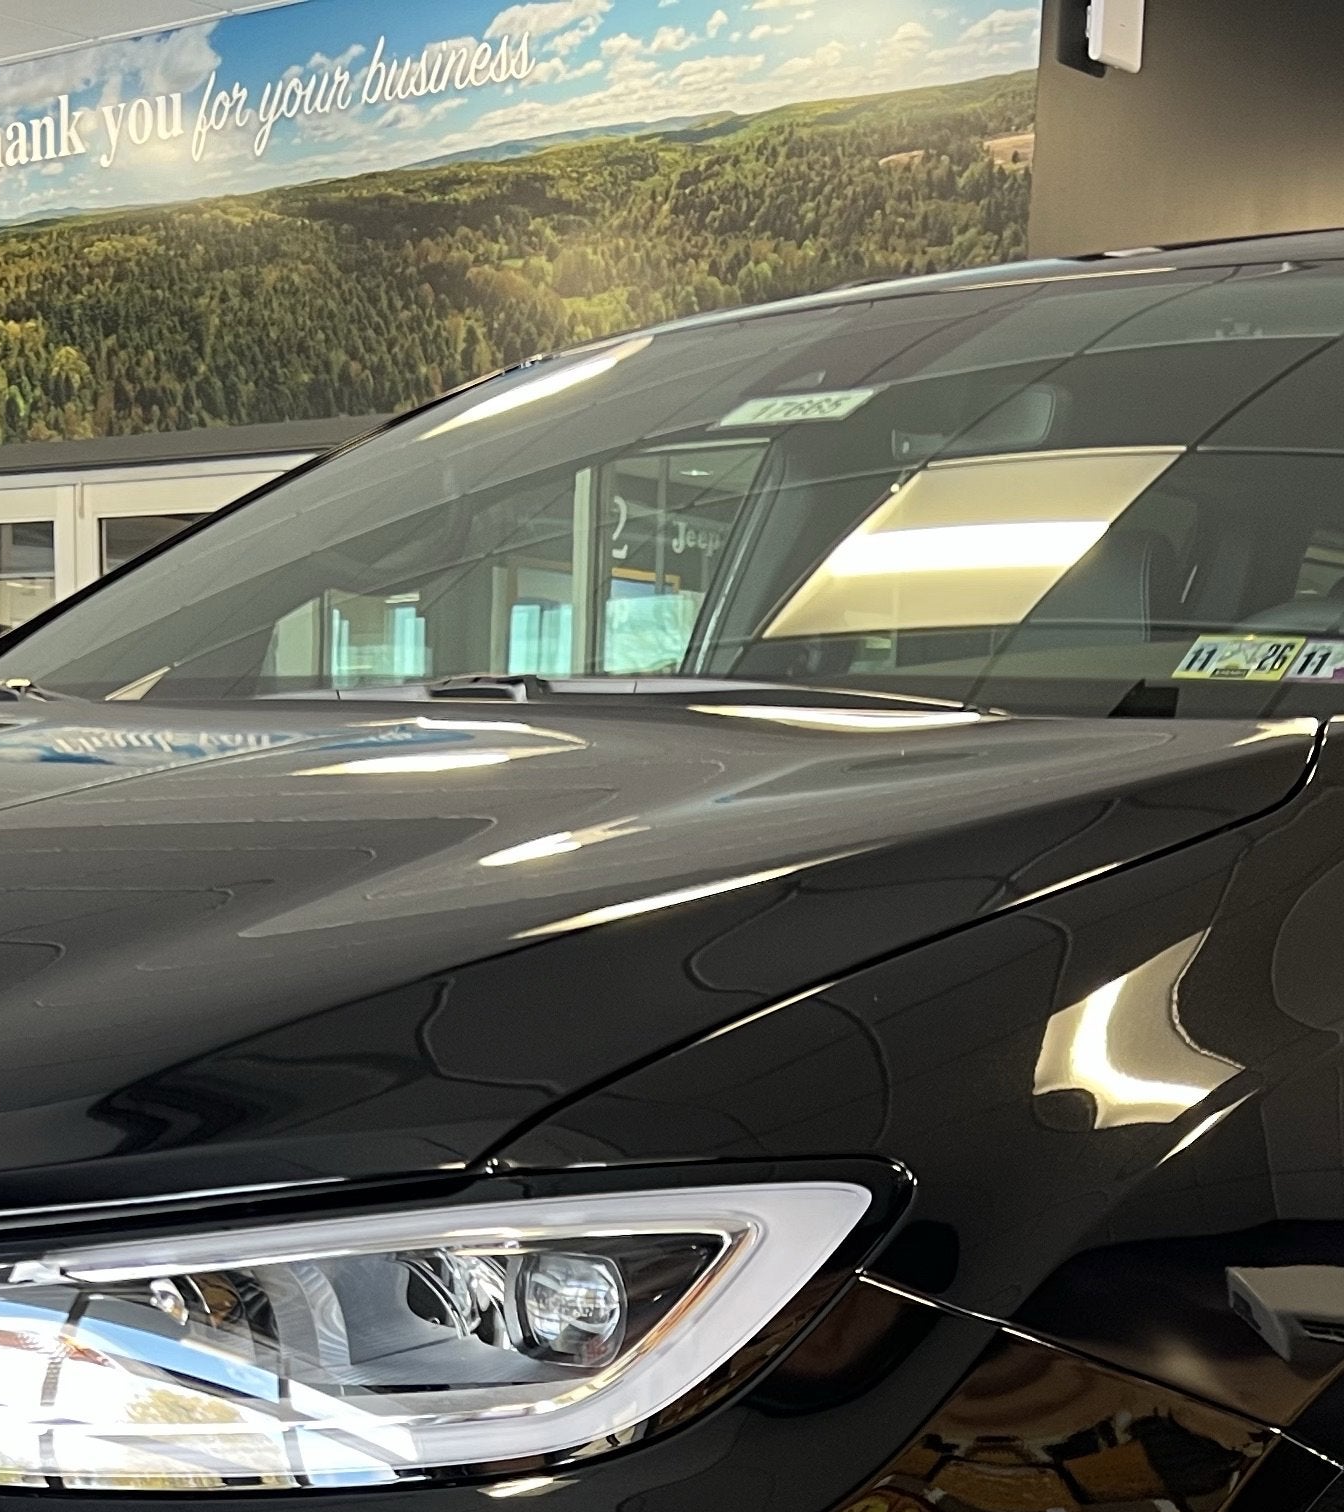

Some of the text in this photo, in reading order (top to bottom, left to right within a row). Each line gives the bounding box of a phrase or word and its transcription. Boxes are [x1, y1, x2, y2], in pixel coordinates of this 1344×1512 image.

[98, 92, 184, 167] you
[189, 70, 250, 161] for
[257, 70, 355, 156] your
[361, 30, 538, 105] business
[671, 519, 722, 557] Jeep
[1184, 642, 1296, 672] 11 26
[1297, 651, 1332, 676] 11
